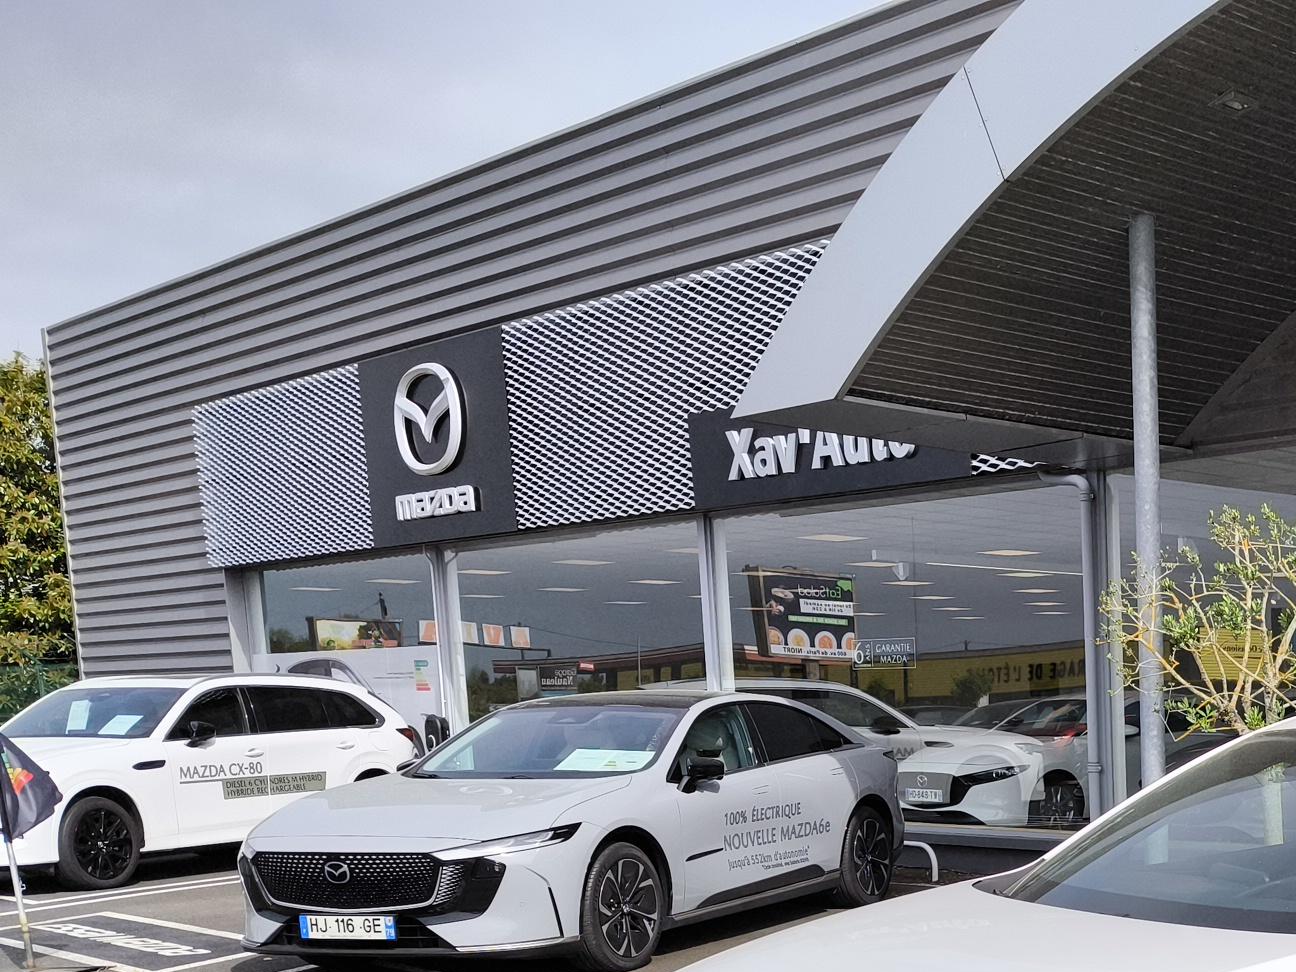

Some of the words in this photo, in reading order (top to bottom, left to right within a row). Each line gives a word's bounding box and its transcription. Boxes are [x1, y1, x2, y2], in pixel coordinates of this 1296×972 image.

[854, 641, 864, 664] 6
[875, 643, 911, 653] GARANTIE
[880, 653, 908, 664] MAZDA
[180, 764, 227, 779] MAZDA
[229, 761, 263, 776] CX-80
[225, 780, 248, 789] DIESEL
[300, 773, 323, 782] HYBRID
[226, 786, 256, 797] HYBRIDE
[256, 783, 307, 795] RECHARGEABLE
[724, 809, 748, 827] 100%
[752, 802, 802, 823] ÉLECTRIQUE
[723, 827, 777, 852] NOUVELLE
[780, 818, 831, 842] MAZDA6e
